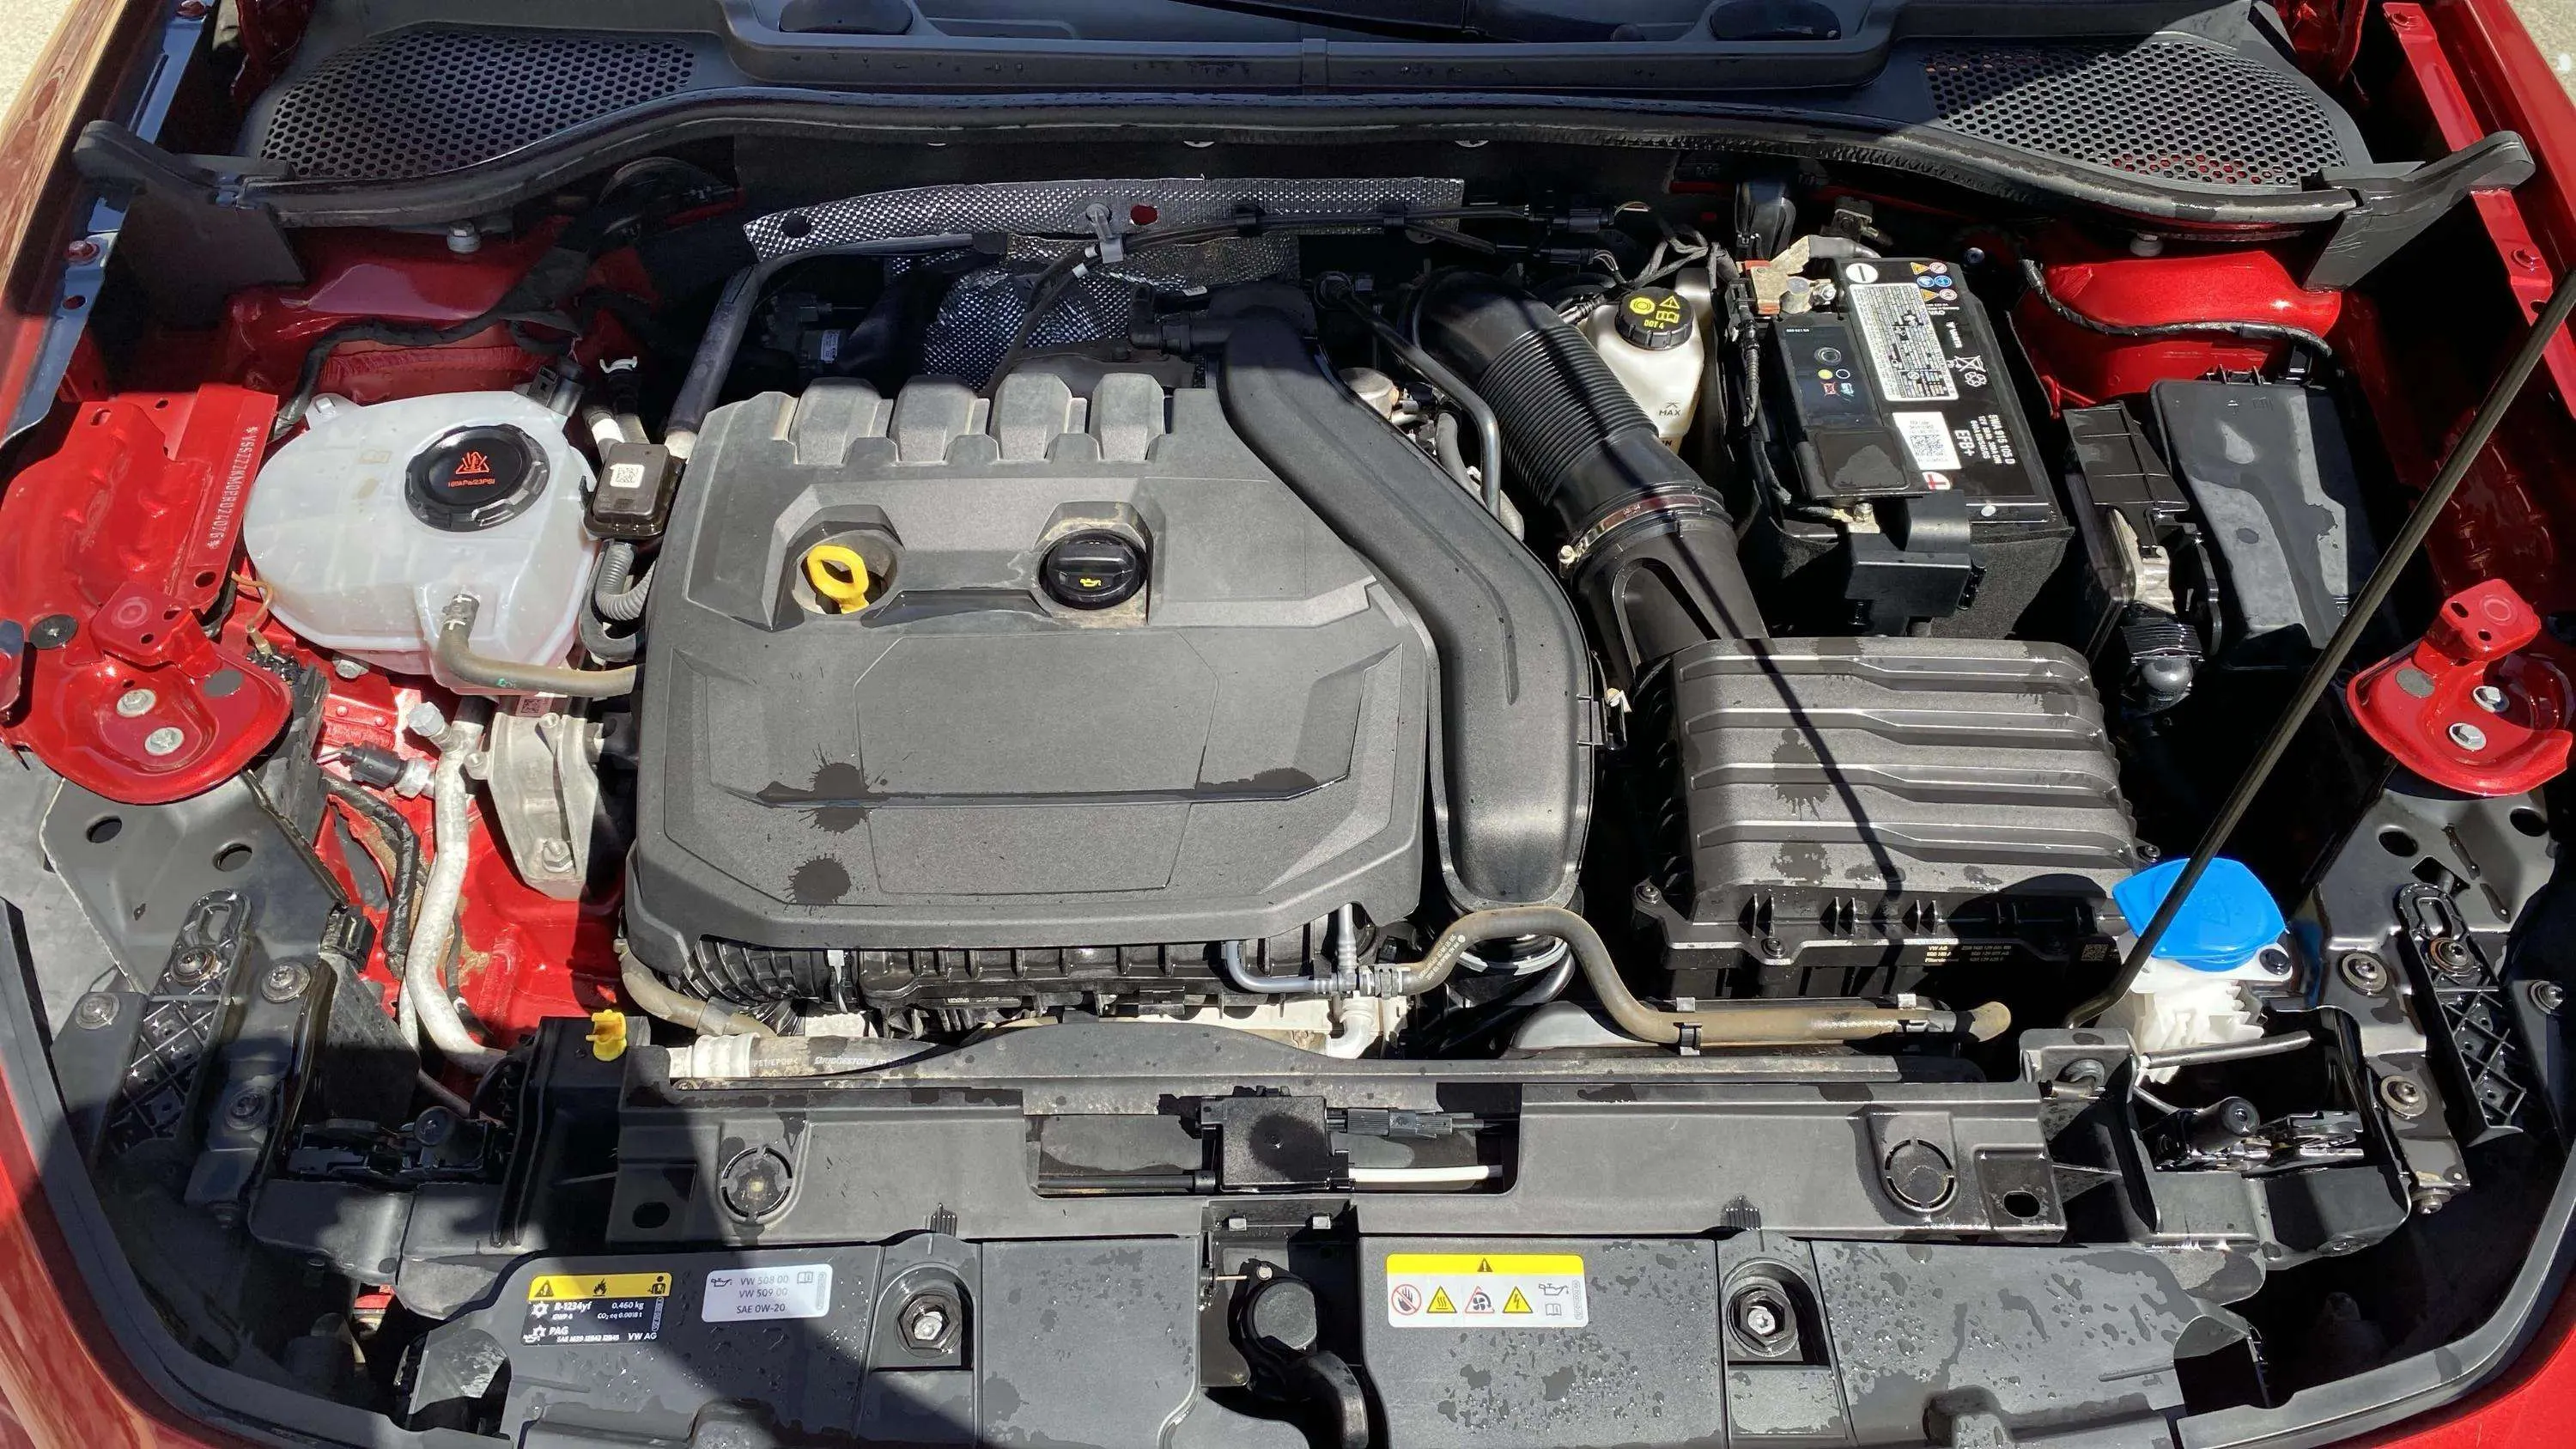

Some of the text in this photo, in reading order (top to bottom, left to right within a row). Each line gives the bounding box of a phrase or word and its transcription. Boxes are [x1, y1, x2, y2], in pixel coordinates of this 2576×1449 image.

[1644, 320, 1658, 328] DOT
[1987, 413, 2003, 429] 5WA
[1993, 429, 2008, 443] 915
[1955, 429, 1975, 456] EFB+
[1998, 443, 2014, 458] 105
[777, 1275, 788, 1284] 00
[776, 1288, 787, 1296] 00
[554, 1302, 592, 1312] R-1234yf
[755, 1304, 785, 1312] 0W-20
